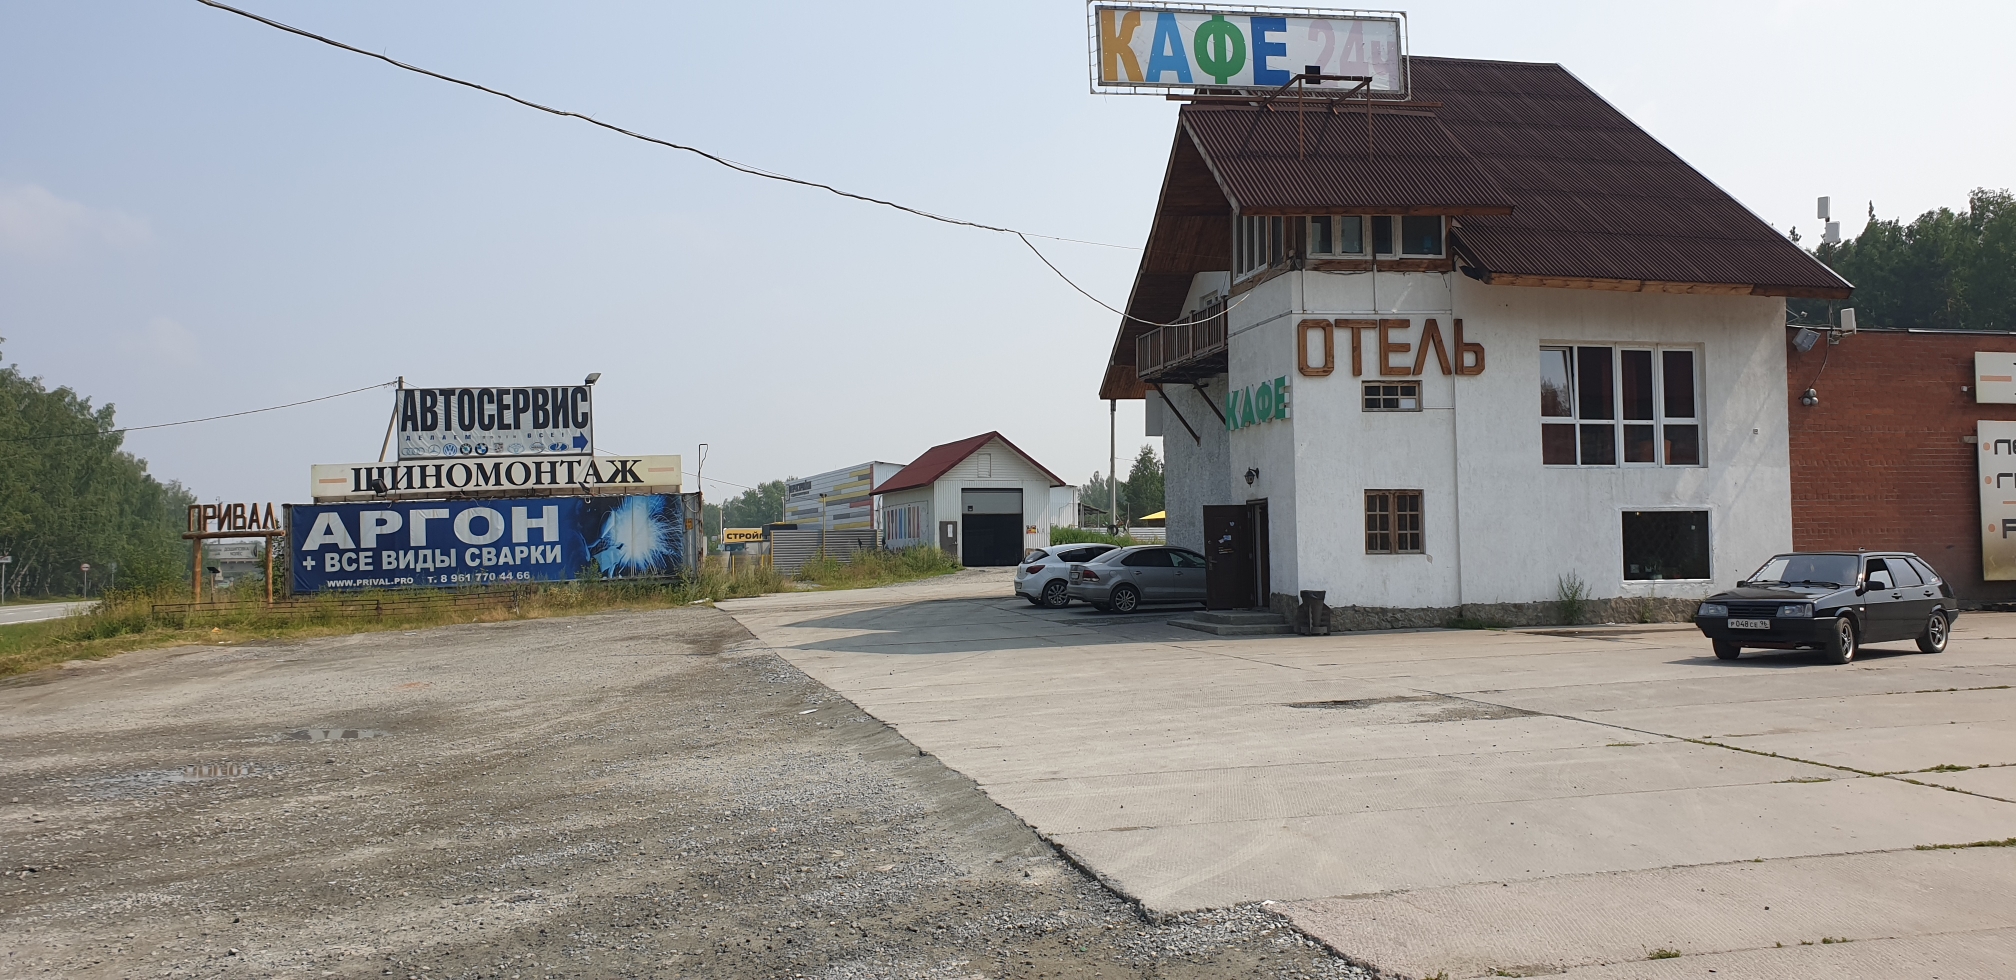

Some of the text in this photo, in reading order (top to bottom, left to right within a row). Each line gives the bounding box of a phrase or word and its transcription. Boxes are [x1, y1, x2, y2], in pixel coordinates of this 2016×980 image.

[1100, 9, 1290, 85] КАФЕ
[1297, 318, 1486, 377] ОТЕЛЬ
[401, 386, 589, 432] АВТОСЕРВИС
[1225, 375, 1290, 431] КАФЕ
[351, 458, 645, 493] ШИНОМОНТАЖ
[188, 502, 277, 532] ПРИВАЛ
[301, 505, 560, 550] АРГОН
[303, 545, 562, 572] + ВСЕ ВИДЫ СВАРКИ
[440, 574, 448, 583] 8
[451, 574, 471, 583] 961
[475, 572, 496, 581] 770
[500, 571, 513, 580] 44
[516, 571, 531, 580] 66
[327, 577, 414, 587] WWW.PRIVAL.PRO
